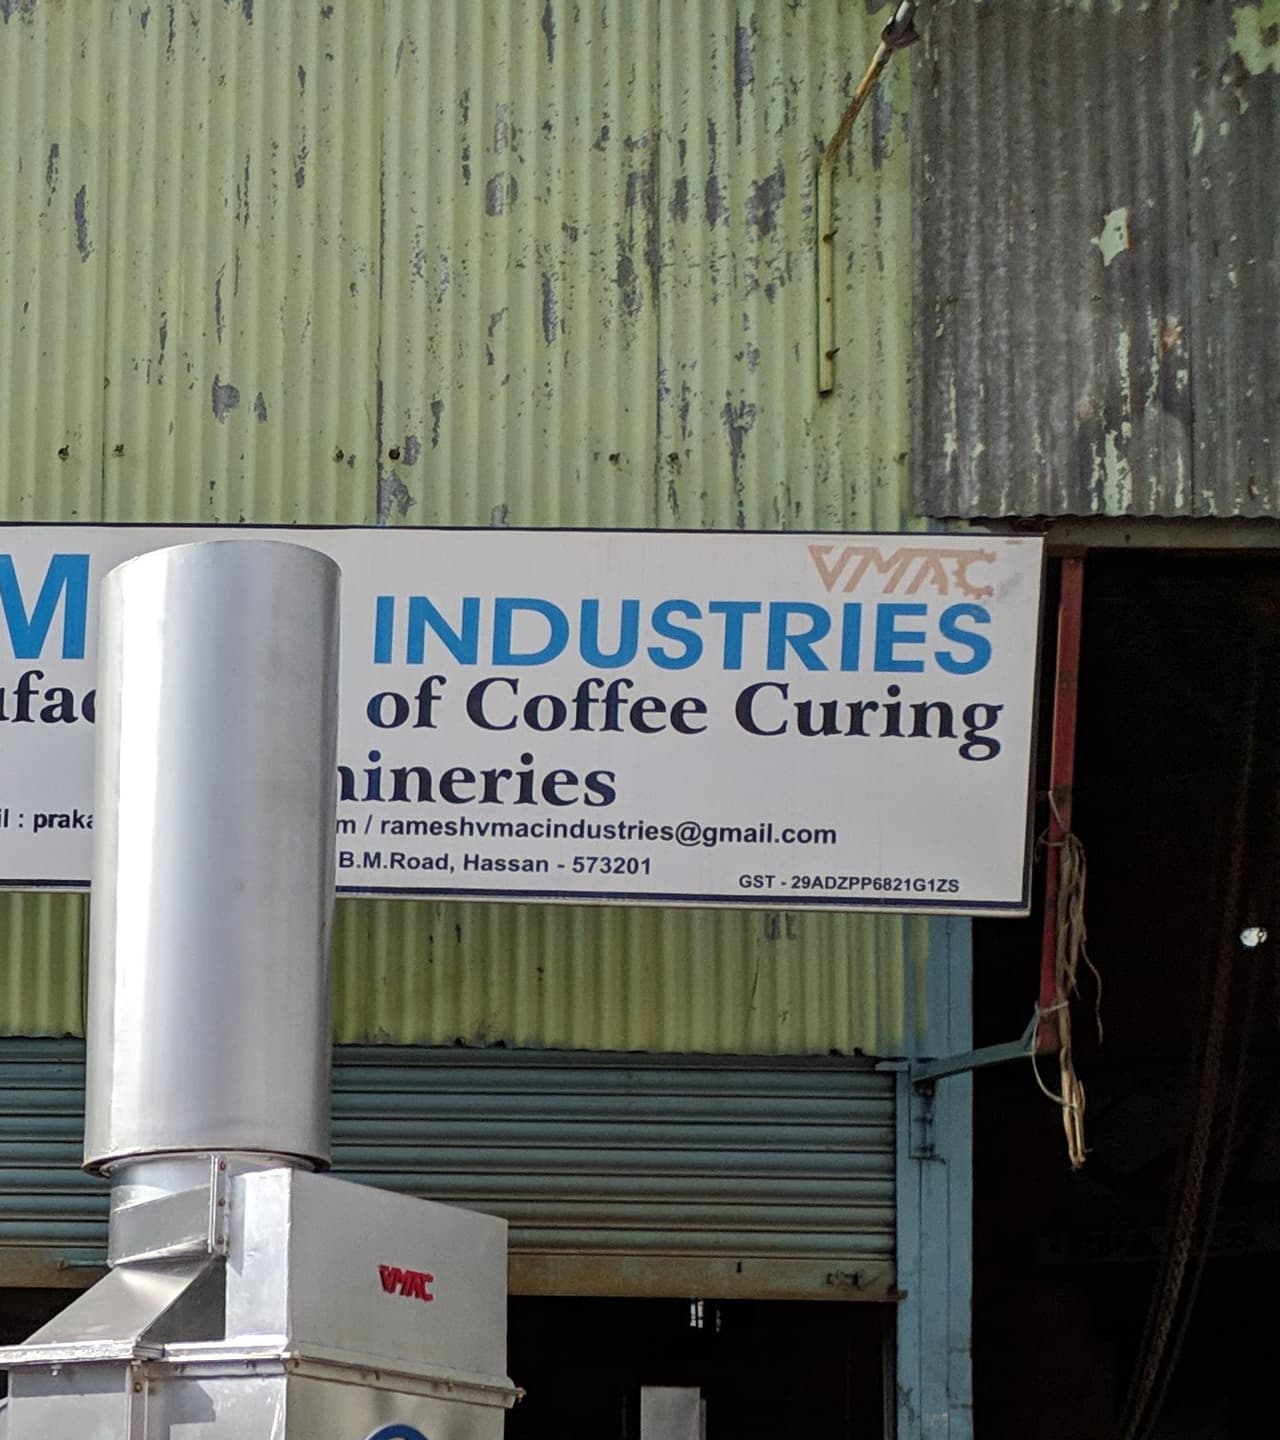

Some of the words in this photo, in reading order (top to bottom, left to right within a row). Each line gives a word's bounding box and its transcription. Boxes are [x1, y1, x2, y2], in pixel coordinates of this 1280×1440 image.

[807, 544, 997, 600] VMAC
[373, 595, 993, 676] INDUSTRIES
[366, 675, 447, 729] of
[465, 676, 708, 735] Coffee
[734, 681, 1005, 762] Curing
[337, 749, 617, 807] ineries
[32, 808, 93, 834] prak
[380, 816, 837, 848] rameshvmacindustries@gmail.com
[339, 850, 455, 874] B.M.Road,
[463, 853, 549, 873] Hassan
[572, 855, 651, 876] 573201
[738, 874, 777, 889] GST
[378, 1263, 434, 1302] VMAC
